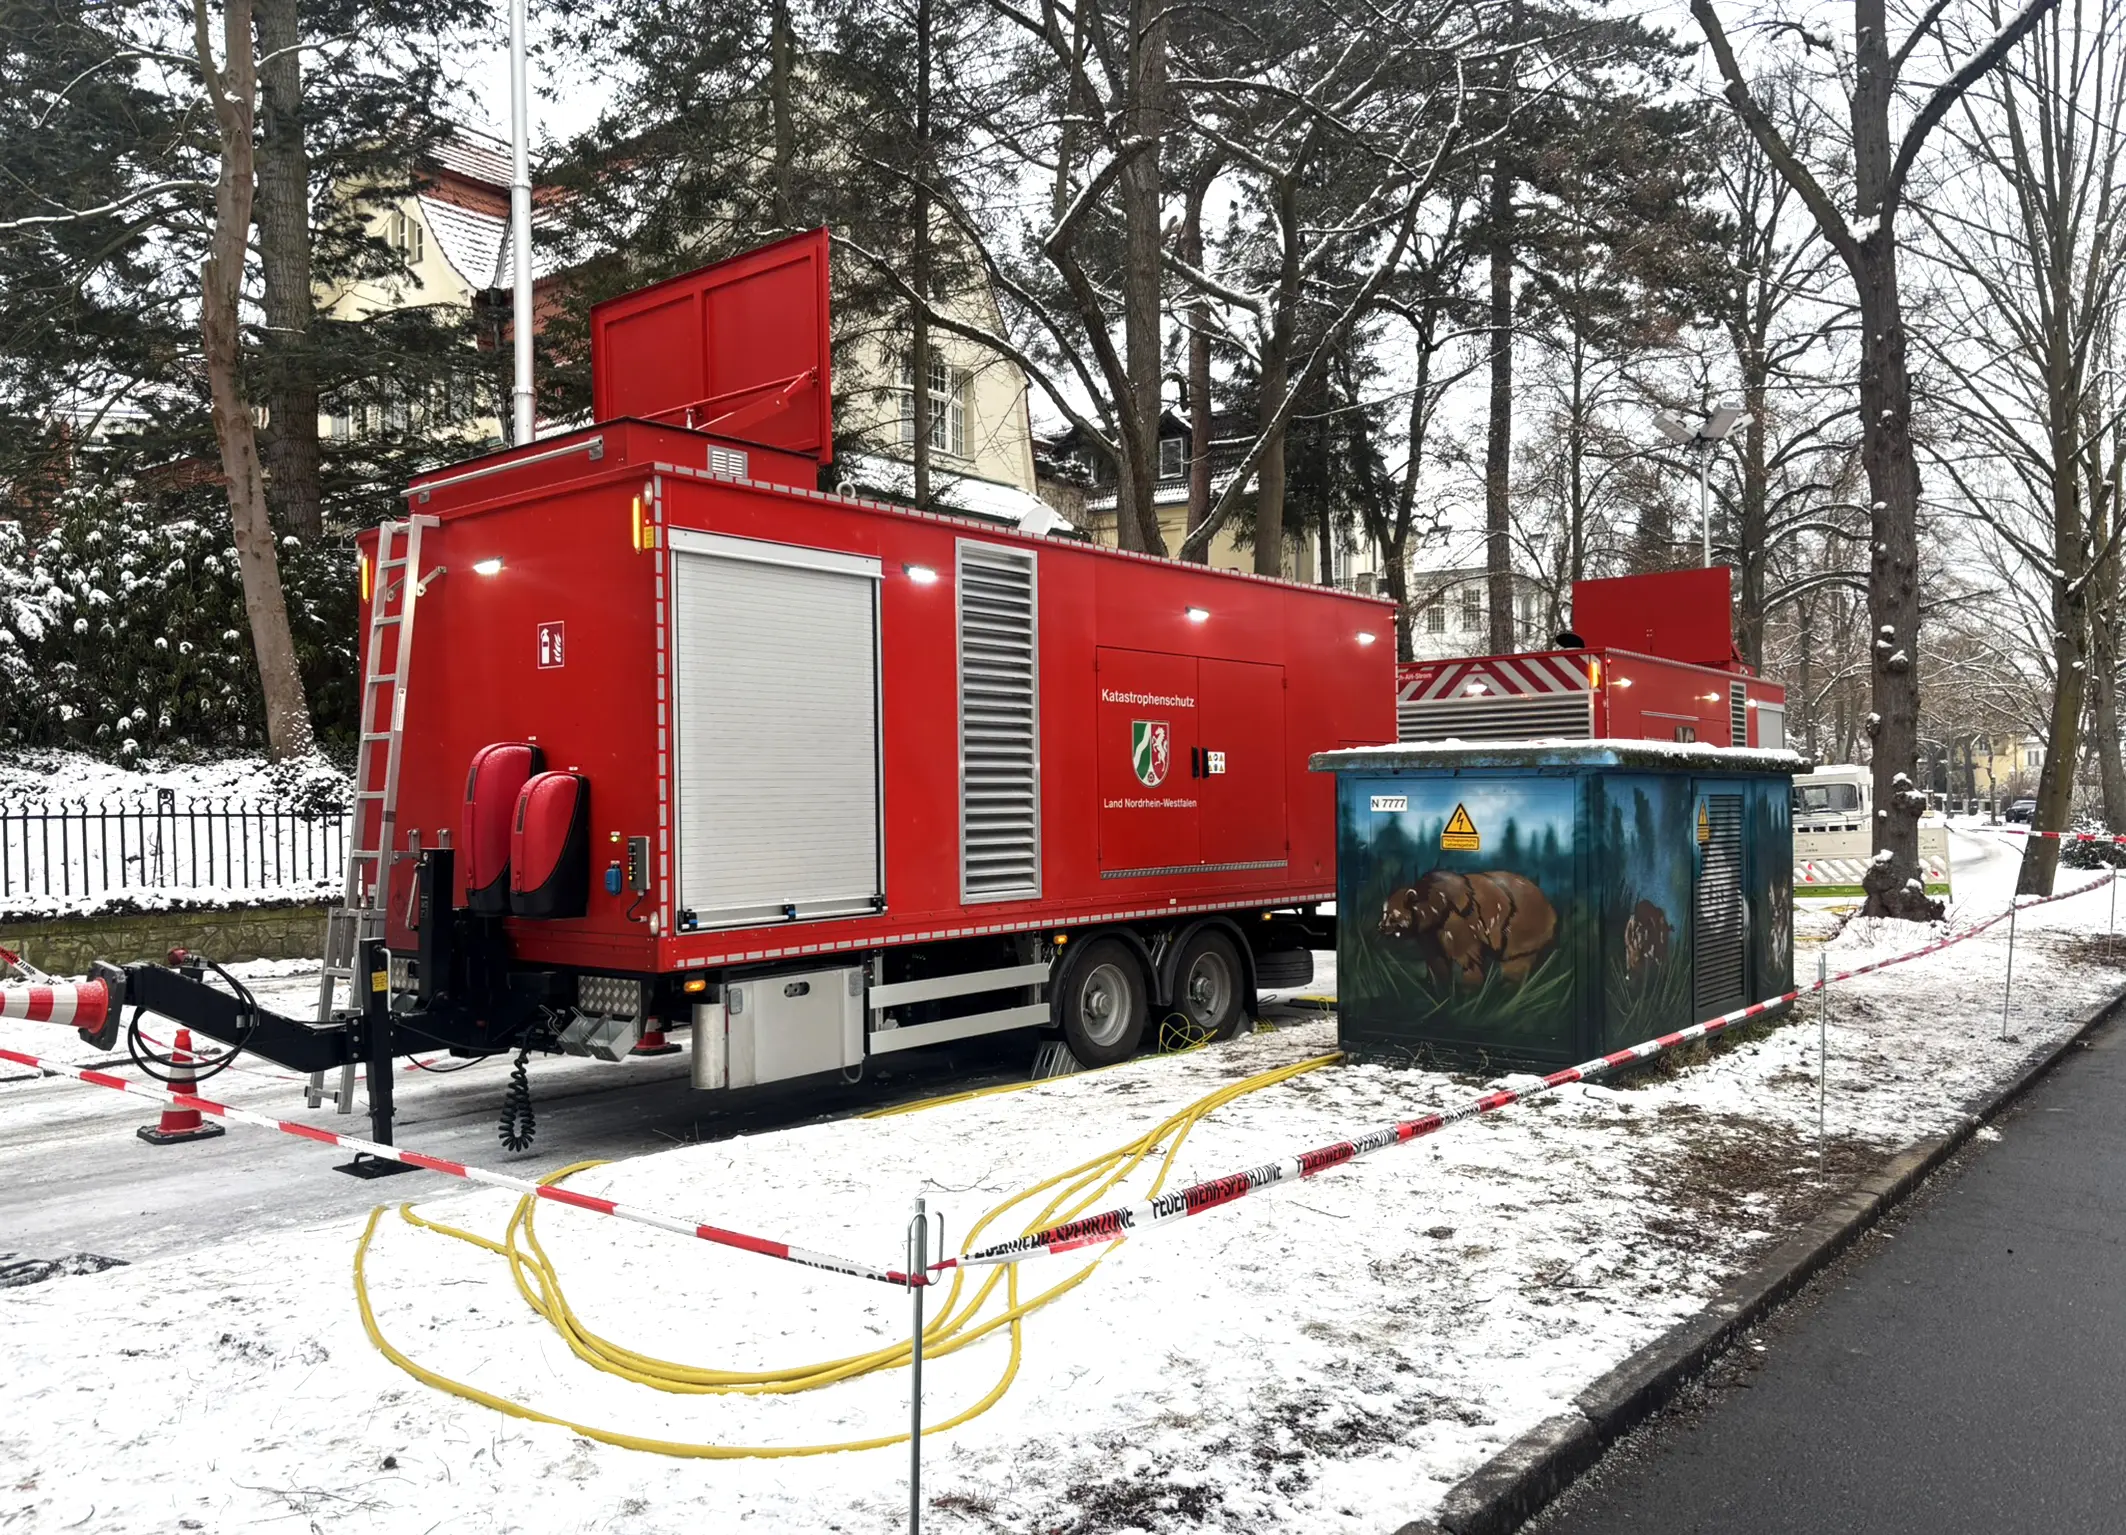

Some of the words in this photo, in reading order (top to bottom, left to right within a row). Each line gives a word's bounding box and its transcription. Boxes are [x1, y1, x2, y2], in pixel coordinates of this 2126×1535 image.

[1101, 688, 1195, 707] Katastrophenschutz
[1103, 798, 1123, 809] Land
[1124, 798, 1197, 809] Nordrhein-Westfalen
[1371, 798, 1379, 808] N
[1382, 798, 1406, 808] 7777
